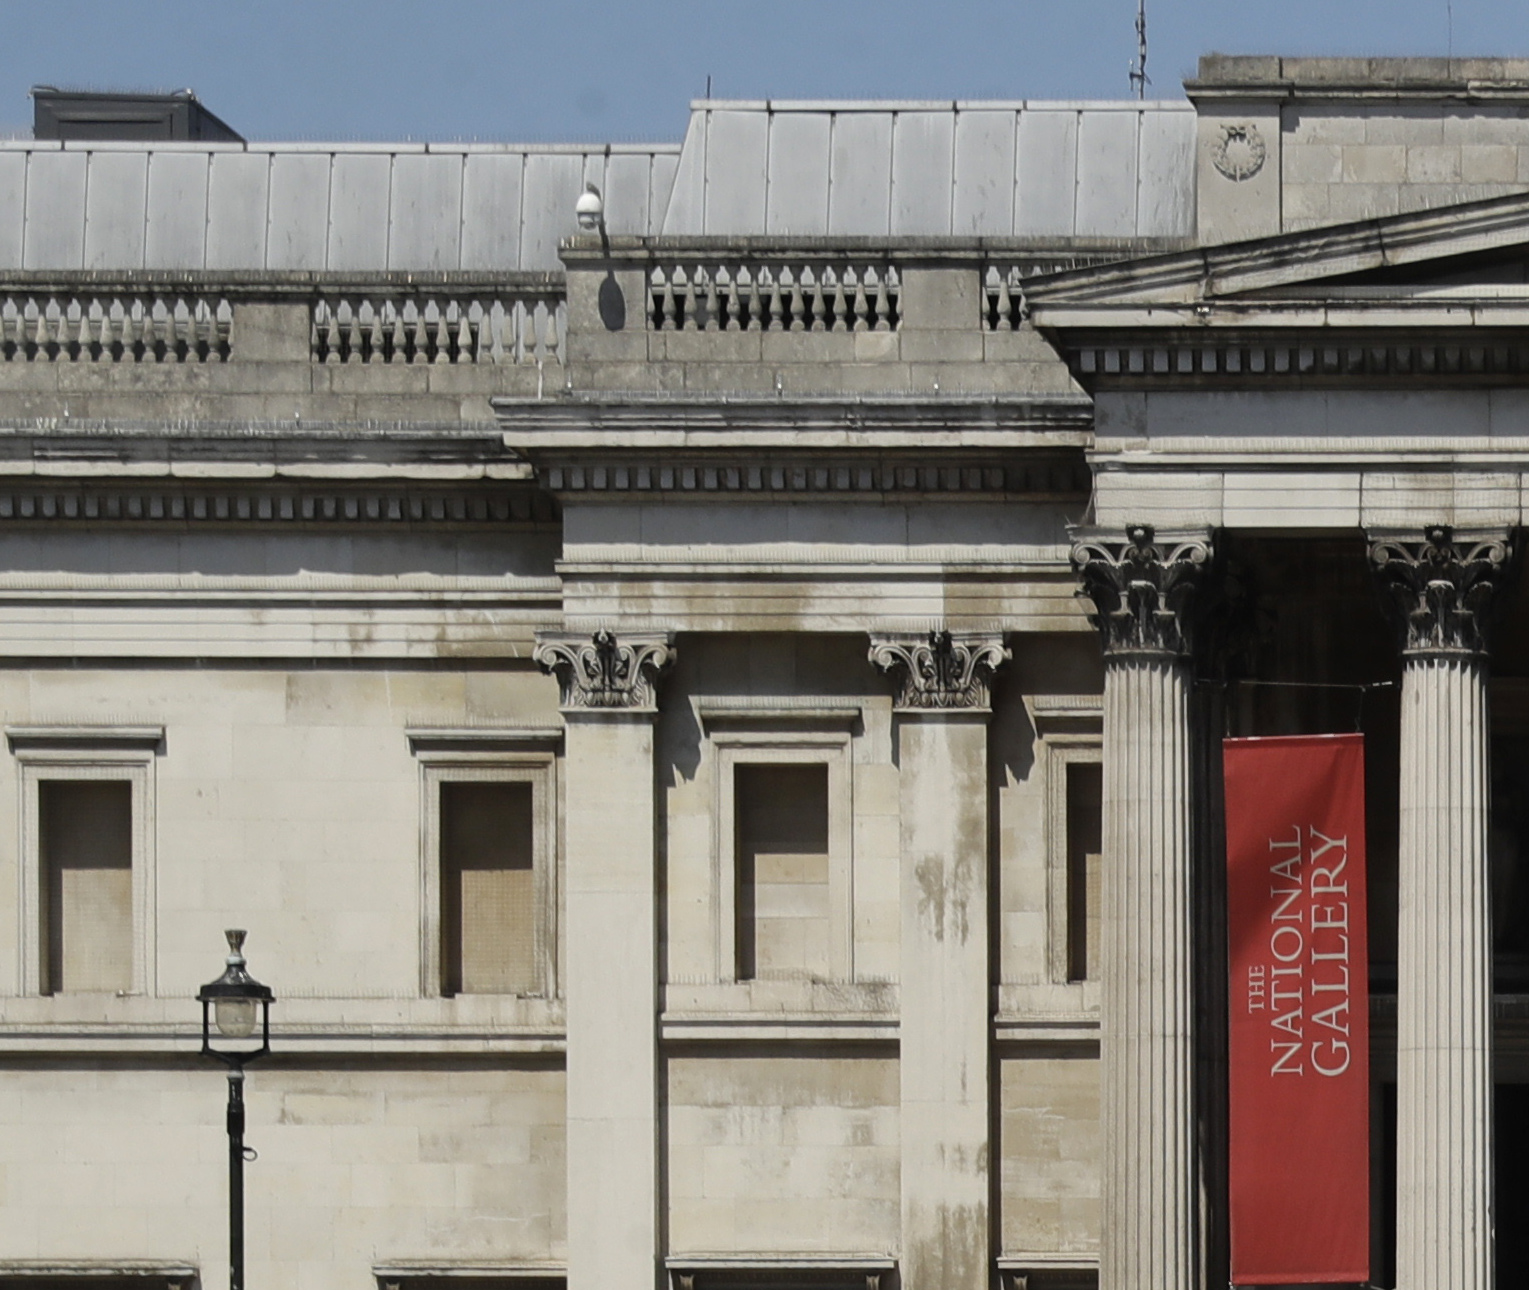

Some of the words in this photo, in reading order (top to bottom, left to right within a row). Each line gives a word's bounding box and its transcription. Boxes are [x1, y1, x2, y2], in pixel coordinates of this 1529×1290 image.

[1249, 964, 1265, 1015] THE
[1269, 824, 1304, 1077] NATIONAL
[1310, 823, 1350, 1077] GALLERY
